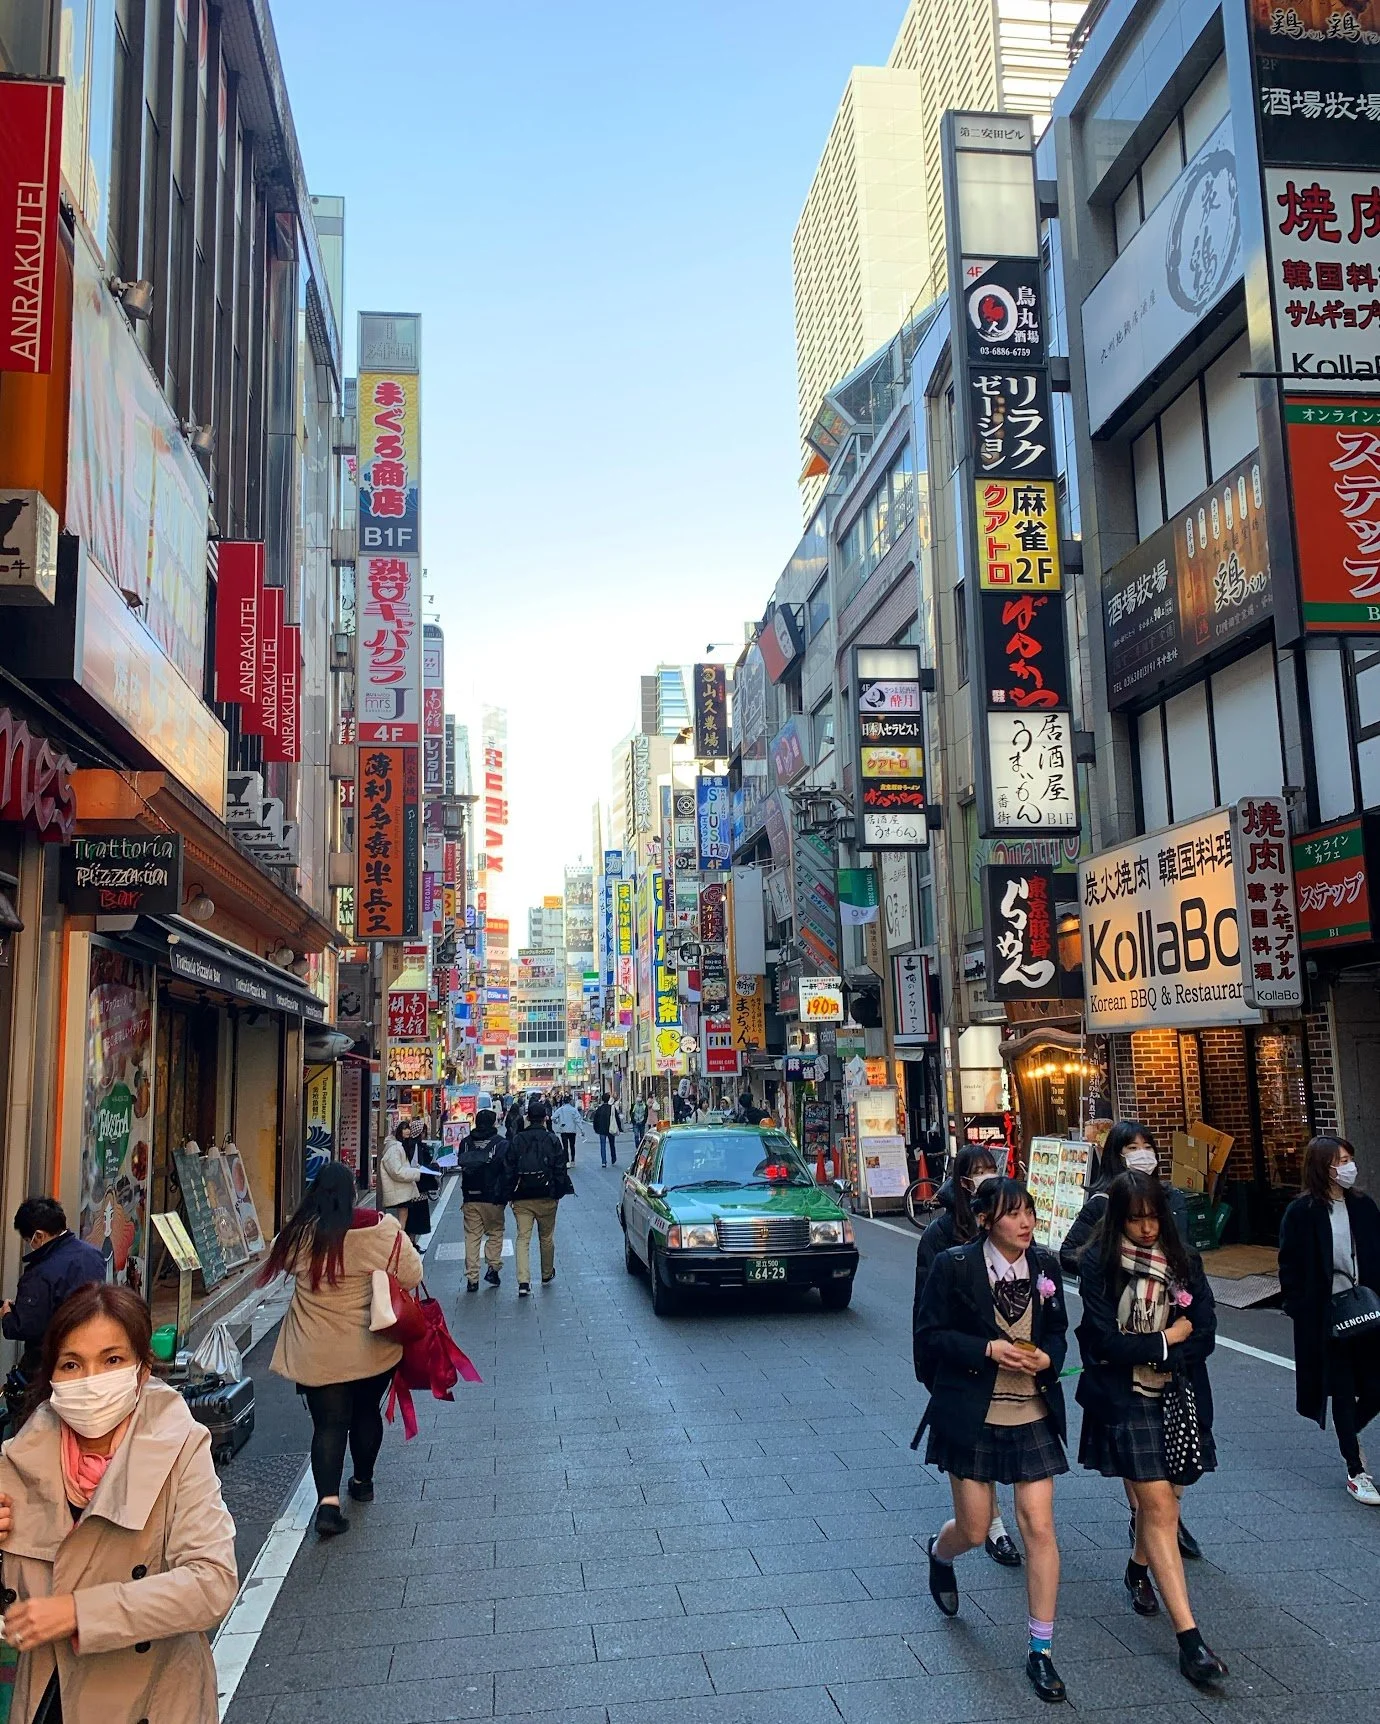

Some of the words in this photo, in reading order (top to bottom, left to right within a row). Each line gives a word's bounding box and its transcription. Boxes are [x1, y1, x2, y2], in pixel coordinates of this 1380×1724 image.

[1261, 87, 1380, 121] 酒場牧場
[959, 126, 1025, 140] 第二安田ビル
[10, 181, 44, 361] ANRAKUTEI
[966, 265, 984, 278] 4F
[1282, 259, 1380, 292] 韓国料
[980, 346, 1031, 358] 03-6886-6759
[1014, 331, 1040, 344] 酒場
[972, 375, 1006, 471] ゼーション
[1005, 375, 1046, 471] リラク
[1302, 409, 1380, 423] オンライン
[370, 381, 408, 518] まぐろ商店
[984, 484, 1013, 585] クアトロ
[1012, 484, 1049, 552] 麻雀
[364, 527, 413, 547] B1F
[1016, 558, 1053, 584] 2F
[1107, 557, 1169, 628] 酒場牧場
[363, 557, 416, 686] 熟女キャバクラ
[239, 597, 256, 697] ANRAKUTEI
[262, 638, 277, 730] ANRAKUTEI
[890, 694, 913, 707] 酔月
[282, 672, 295, 757] ANRAKUTEI
[862, 722, 920, 736] 日本人セラピスト
[374, 724, 404, 742] 4F
[425, 738, 439, 782] レンタル
[867, 760, 908, 769] クアトロ
[1008, 719, 1043, 825] うまいもん
[1037, 713, 1070, 801] 居酒屋
[708, 788, 719, 856] SLUSH
[867, 815, 900, 825] 居酒屋
[996, 785, 1012, 825] 一番街
[1047, 812, 1074, 825] B1F
[1242, 801, 1286, 875] 焼肉
[1304, 835, 1349, 856] オンライン
[707, 859, 722, 870] 4F
[1085, 855, 1150, 906] 炭火焼肉
[1157, 829, 1232, 887] 韓国料理
[1315, 850, 1341, 864] カフェ
[1300, 872, 1365, 913] ステップ
[706, 904, 714, 939] カリーナ
[1248, 883, 1275, 982] 韓国料理
[1270, 882, 1295, 981] サムギョプサル
[1088, 896, 1240, 986] KollaBo
[807, 998, 839, 1015] 190円
[1090, 993, 1127, 1014] Korean
[1130, 988, 1157, 1011] BBQ
[1161, 986, 1171, 1007] &
[1257, 989, 1299, 1001] KollaBo
[755, 1267, 785, 1279] 64-29
